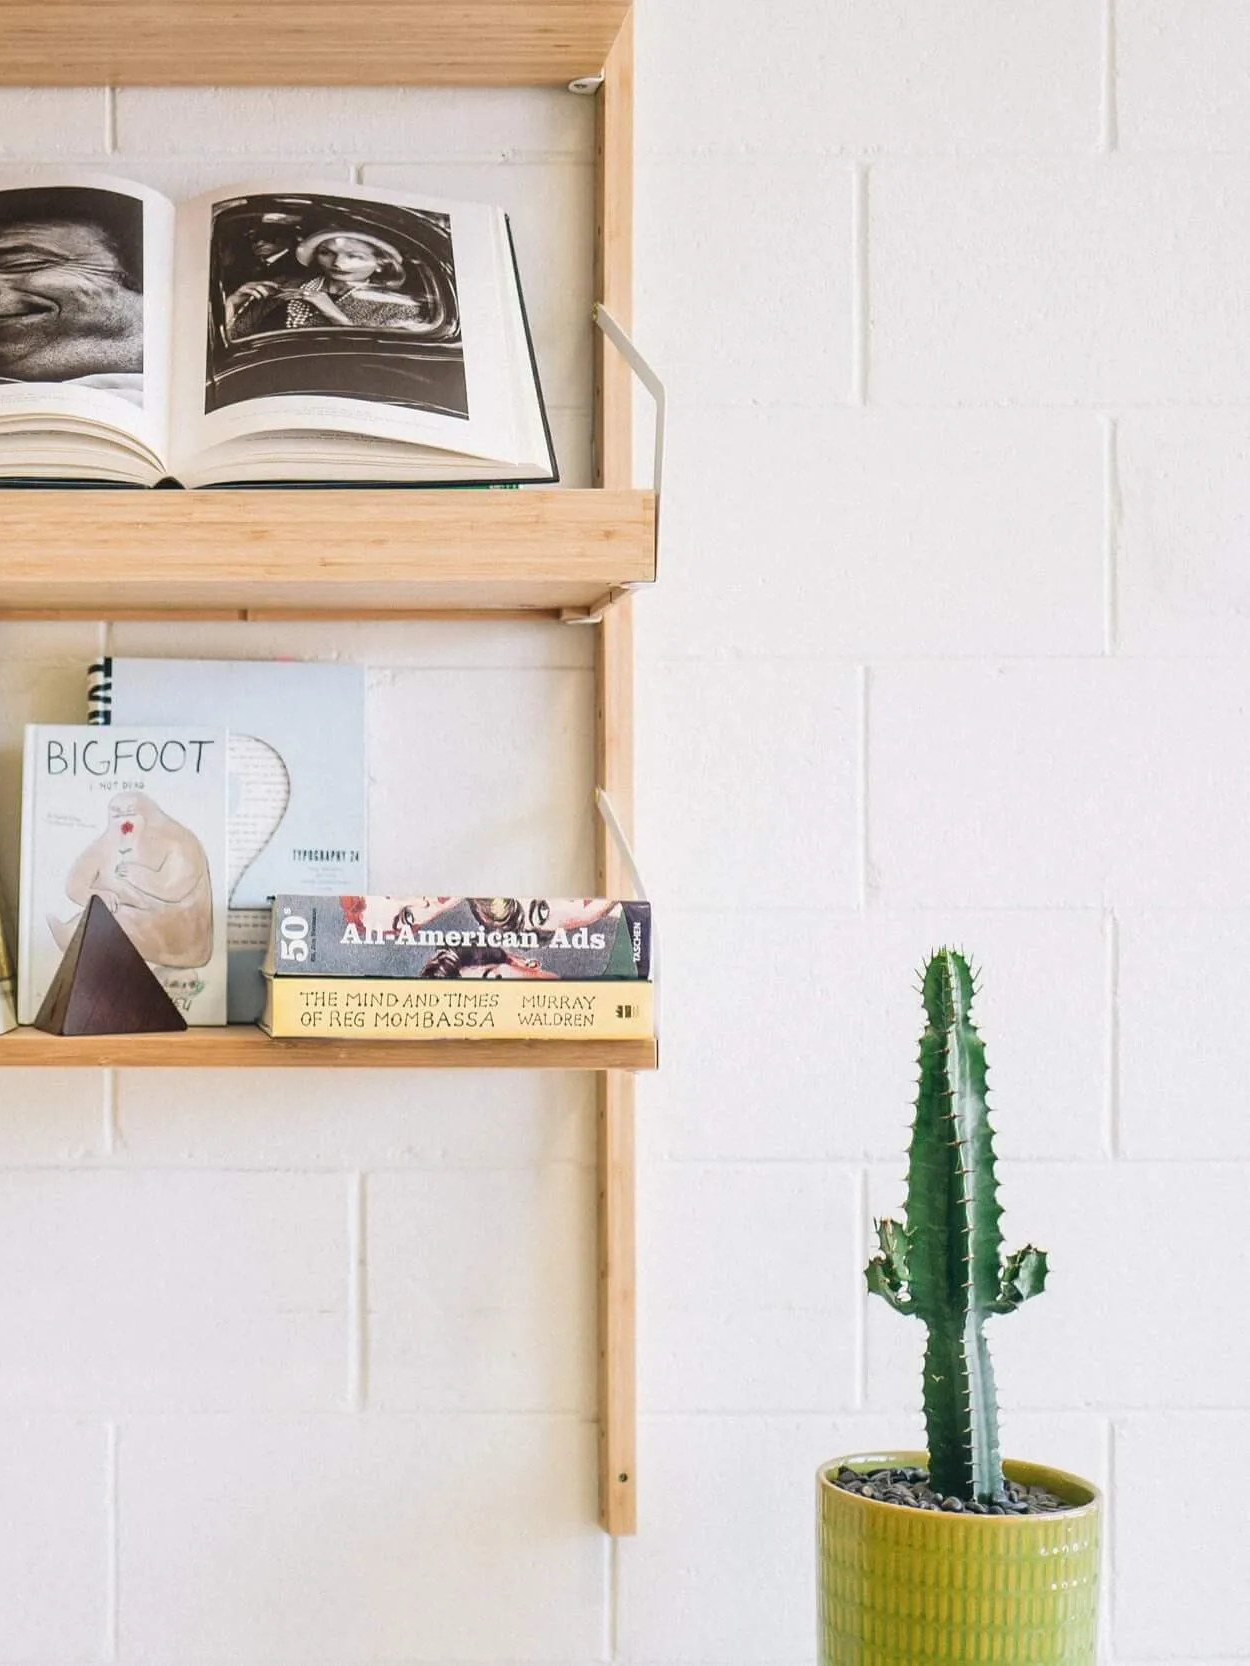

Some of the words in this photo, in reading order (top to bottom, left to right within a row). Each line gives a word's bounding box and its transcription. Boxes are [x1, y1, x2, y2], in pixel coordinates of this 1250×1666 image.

[47, 740, 215, 776] BIGFOOT
[100, 781, 119, 791] NOT
[293, 849, 346, 862] TYPOGRAPHY
[350, 850, 360, 862] 24
[340, 922, 540, 949] All-American
[549, 928, 606, 950] Ads
[632, 922, 642, 962] TASCHEN
[300, 991, 338, 1007] THE
[345, 992, 399, 1008] MIND
[402, 993, 440, 1008] AND
[443, 993, 500, 1008] TIMES
[522, 995, 596, 1010] MURRAY
[300, 1011, 323, 1027] OF
[329, 1010, 366, 1028] REG
[374, 1011, 496, 1028] MOMBASSA
[518, 1013, 595, 1027] WALDREN
